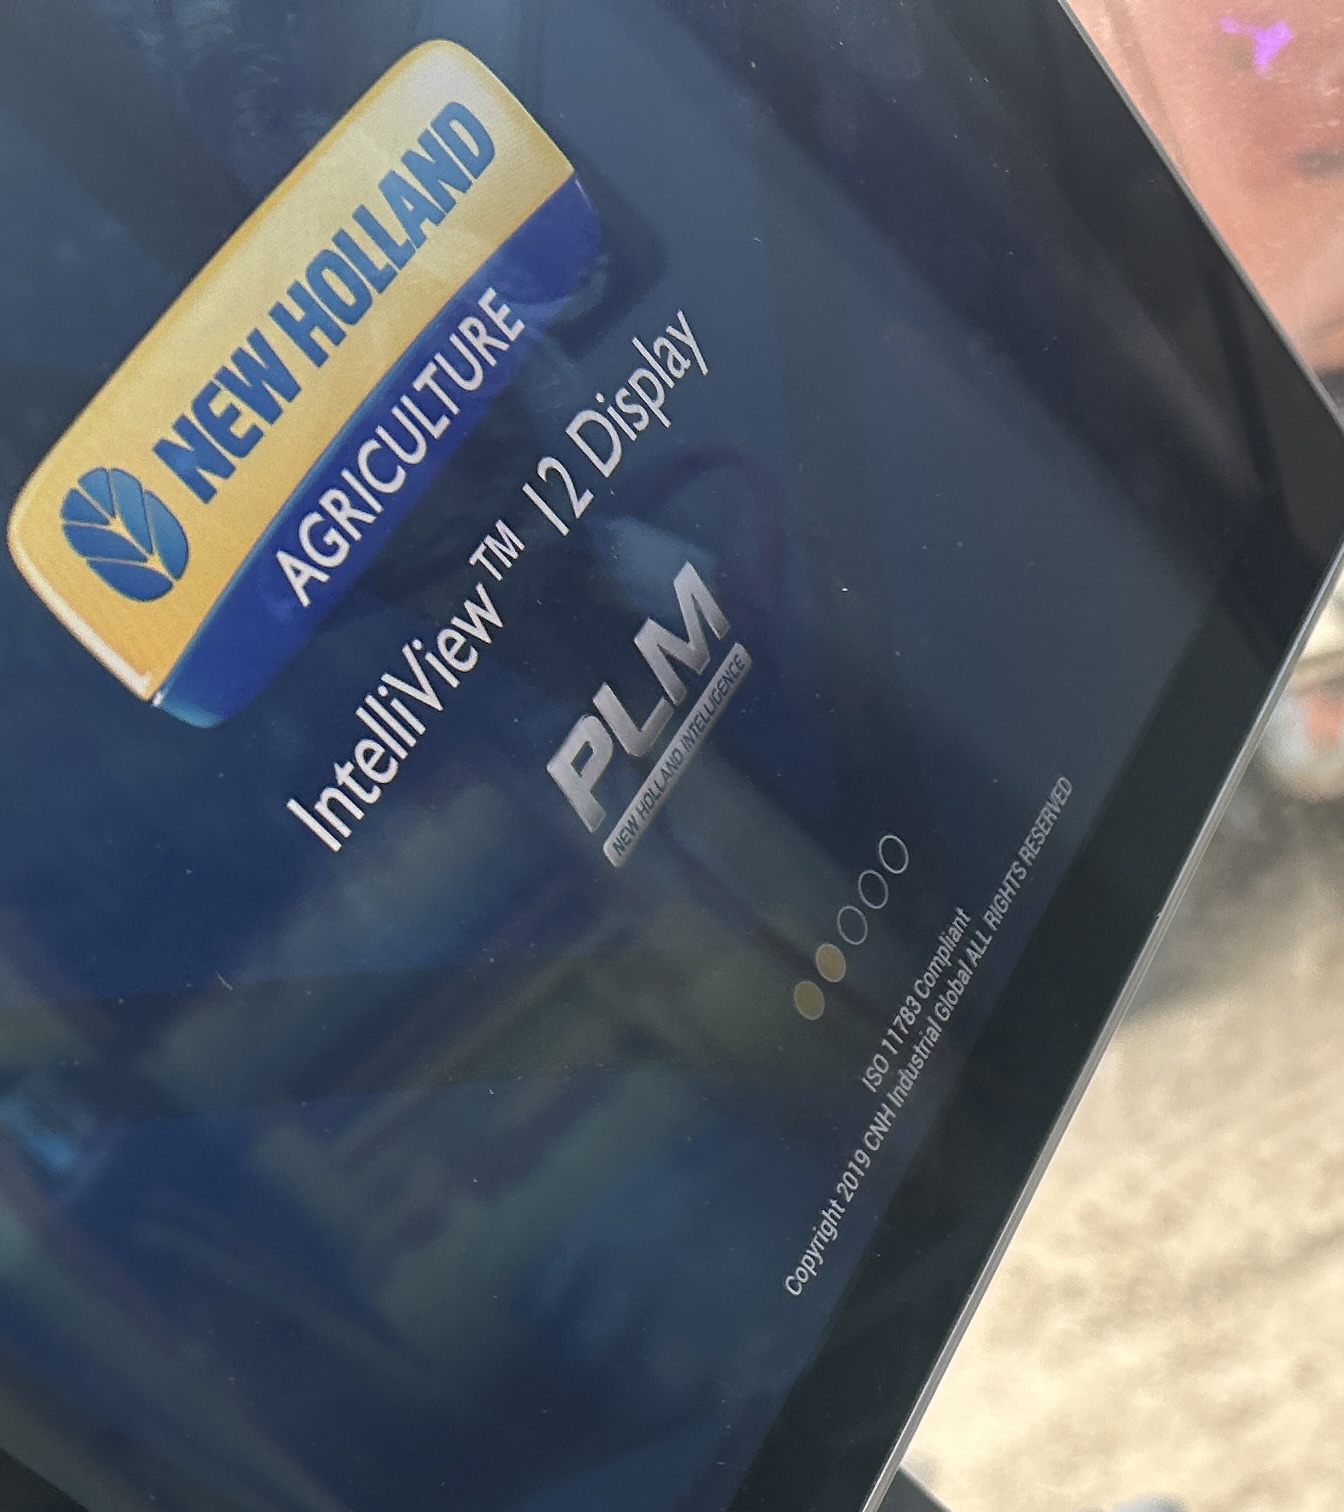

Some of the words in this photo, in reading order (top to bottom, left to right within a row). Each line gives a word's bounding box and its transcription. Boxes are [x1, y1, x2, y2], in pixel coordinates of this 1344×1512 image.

[152, 326, 304, 505] NEW
[271, 100, 497, 370] HOLLAND
[566, 310, 705, 477] Display
[276, 287, 525, 607] AGRICULTURE
[547, 561, 731, 833] PLM
[612, 816, 640, 857] NEW
[638, 748, 684, 822] HOLLAND
[682, 654, 745, 755] INTELLIGENCE
[785, 1197, 847, 1297] Copyright
[836, 1149, 873, 1200] 2019
[865, 1104, 898, 1152] CNH
[889, 1017, 943, 1110] Industrial
[935, 964, 977, 1020] Global
[967, 931, 993, 969] ALL
[983, 860, 1028, 931] RIGHTS
[1020, 776, 1074, 868] RESERVED
[863, 1057, 891, 1094] ISO
[882, 996, 922, 1058] 11783
[916, 906, 971, 1000] Compliant
